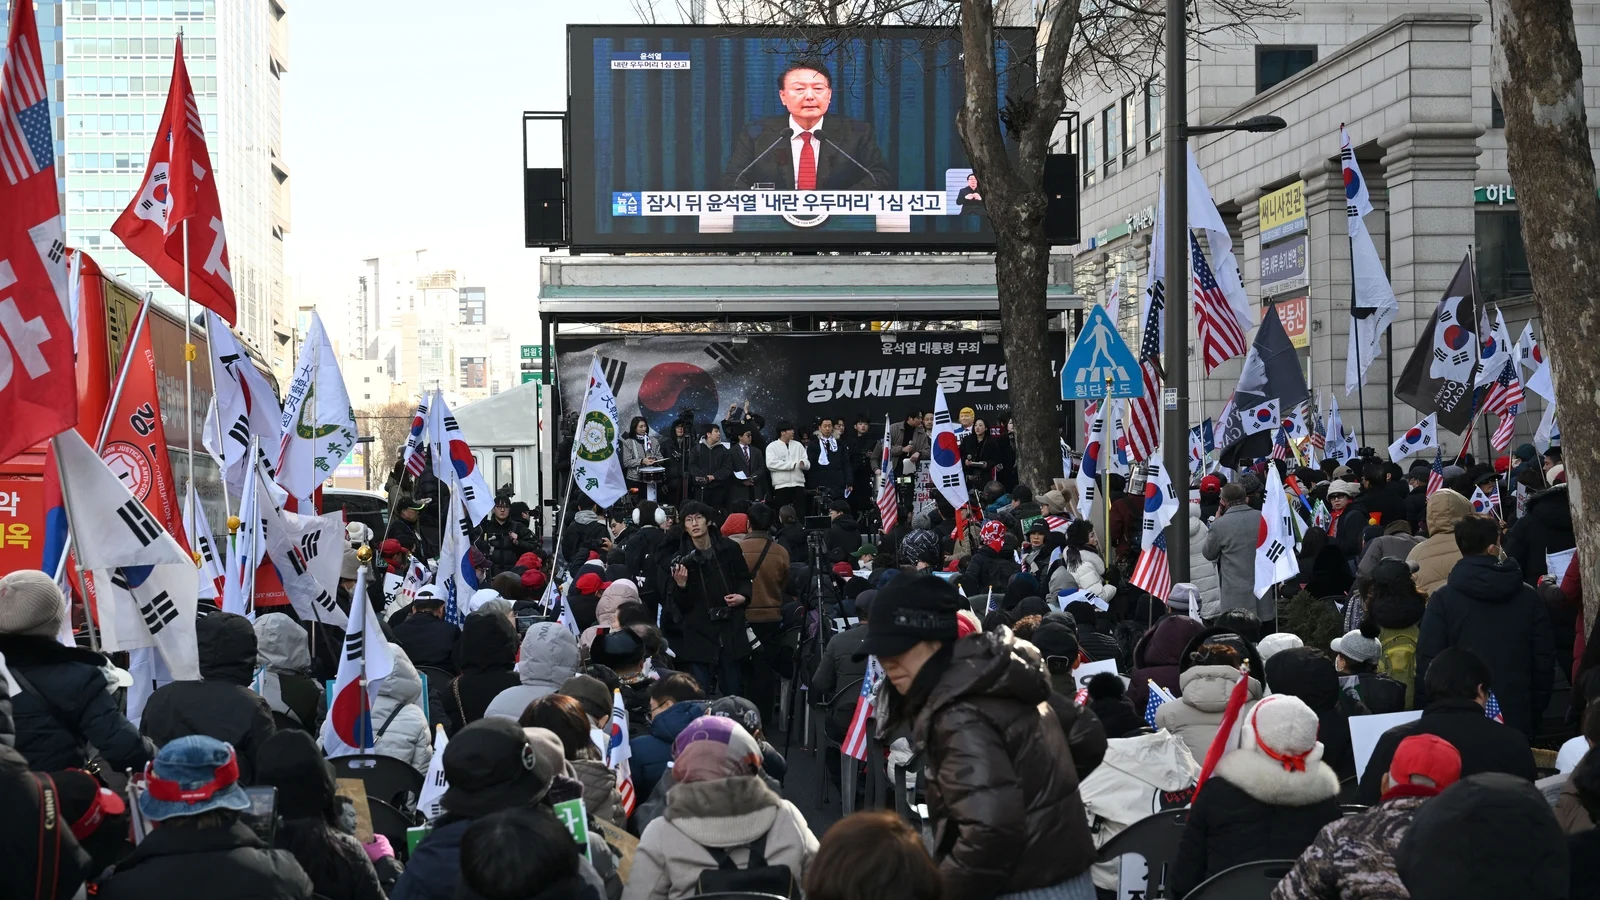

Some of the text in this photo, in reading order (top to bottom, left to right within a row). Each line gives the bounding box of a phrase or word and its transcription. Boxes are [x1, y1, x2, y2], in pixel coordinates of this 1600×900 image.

[630, 61, 659, 69] 우두머리
[616, 197, 638, 205] 뉴스
[646, 193, 942, 212] 잠시 뒤 윤석열 '내란 우두머리' 1심 선고
[1261, 185, 1302, 225] 써니사진관
[881, 341, 980, 355] 윤석열 대통령 무죄
[807, 367, 927, 403] 정치재판
[975, 403, 994, 411] With
[116, 445, 141, 461] JUSTICE
[44, 789, 56, 830] Canon
